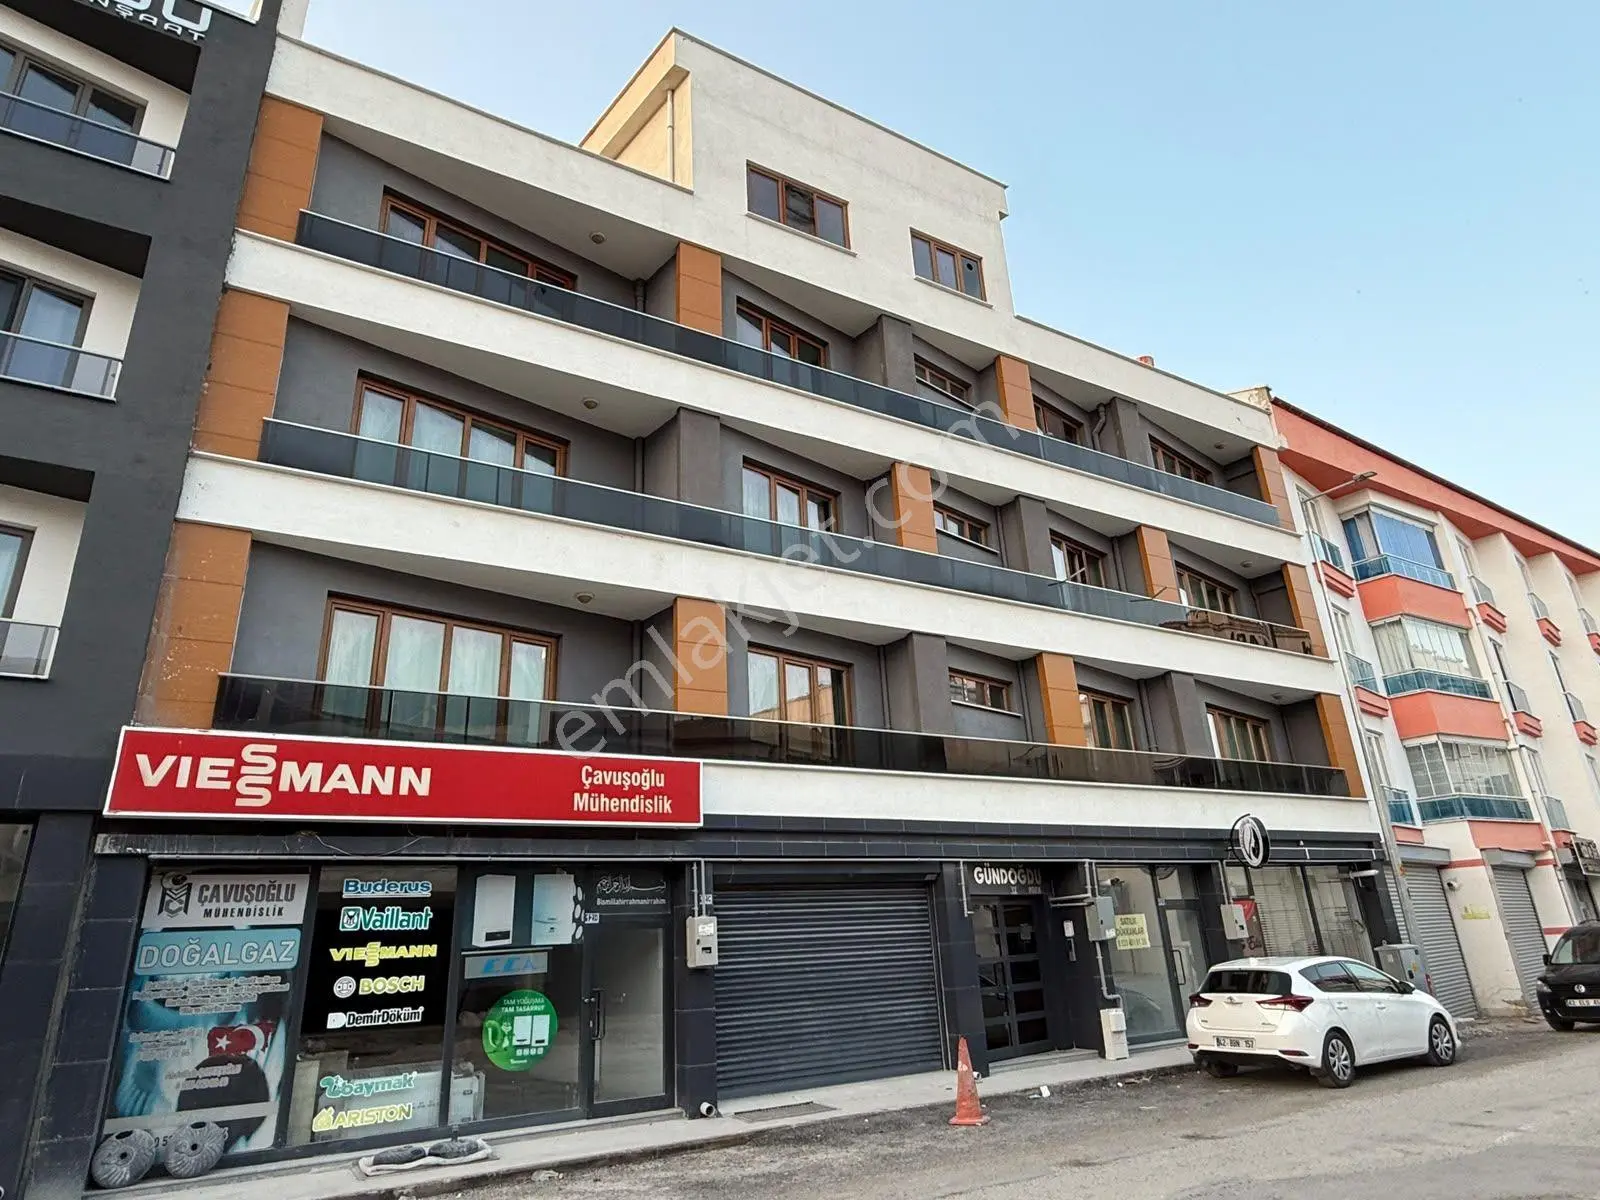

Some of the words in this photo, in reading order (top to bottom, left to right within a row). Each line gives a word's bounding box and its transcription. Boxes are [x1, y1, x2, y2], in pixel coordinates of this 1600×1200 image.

[135, 743, 432, 807] VIESSMANN
[580, 764, 666, 791] Çavuşoğlu
[573, 790, 673, 815] Mühendislik
[973, 862, 1042, 885] GÜNDOĞDU
[197, 880, 297, 906] ÇAVUŞOĞLU
[344, 879, 432, 894] Buderus
[203, 906, 285, 918] MÜHENDİSLİK
[362, 907, 432, 930] Vaillant
[138, 938, 296, 969] DOĞALGAZ
[329, 942, 437, 967] VIESSMANN
[359, 976, 425, 995] BOSCH
[346, 1008, 422, 1027] DemirDöküm
[334, 1103, 412, 1128] ARISTON
